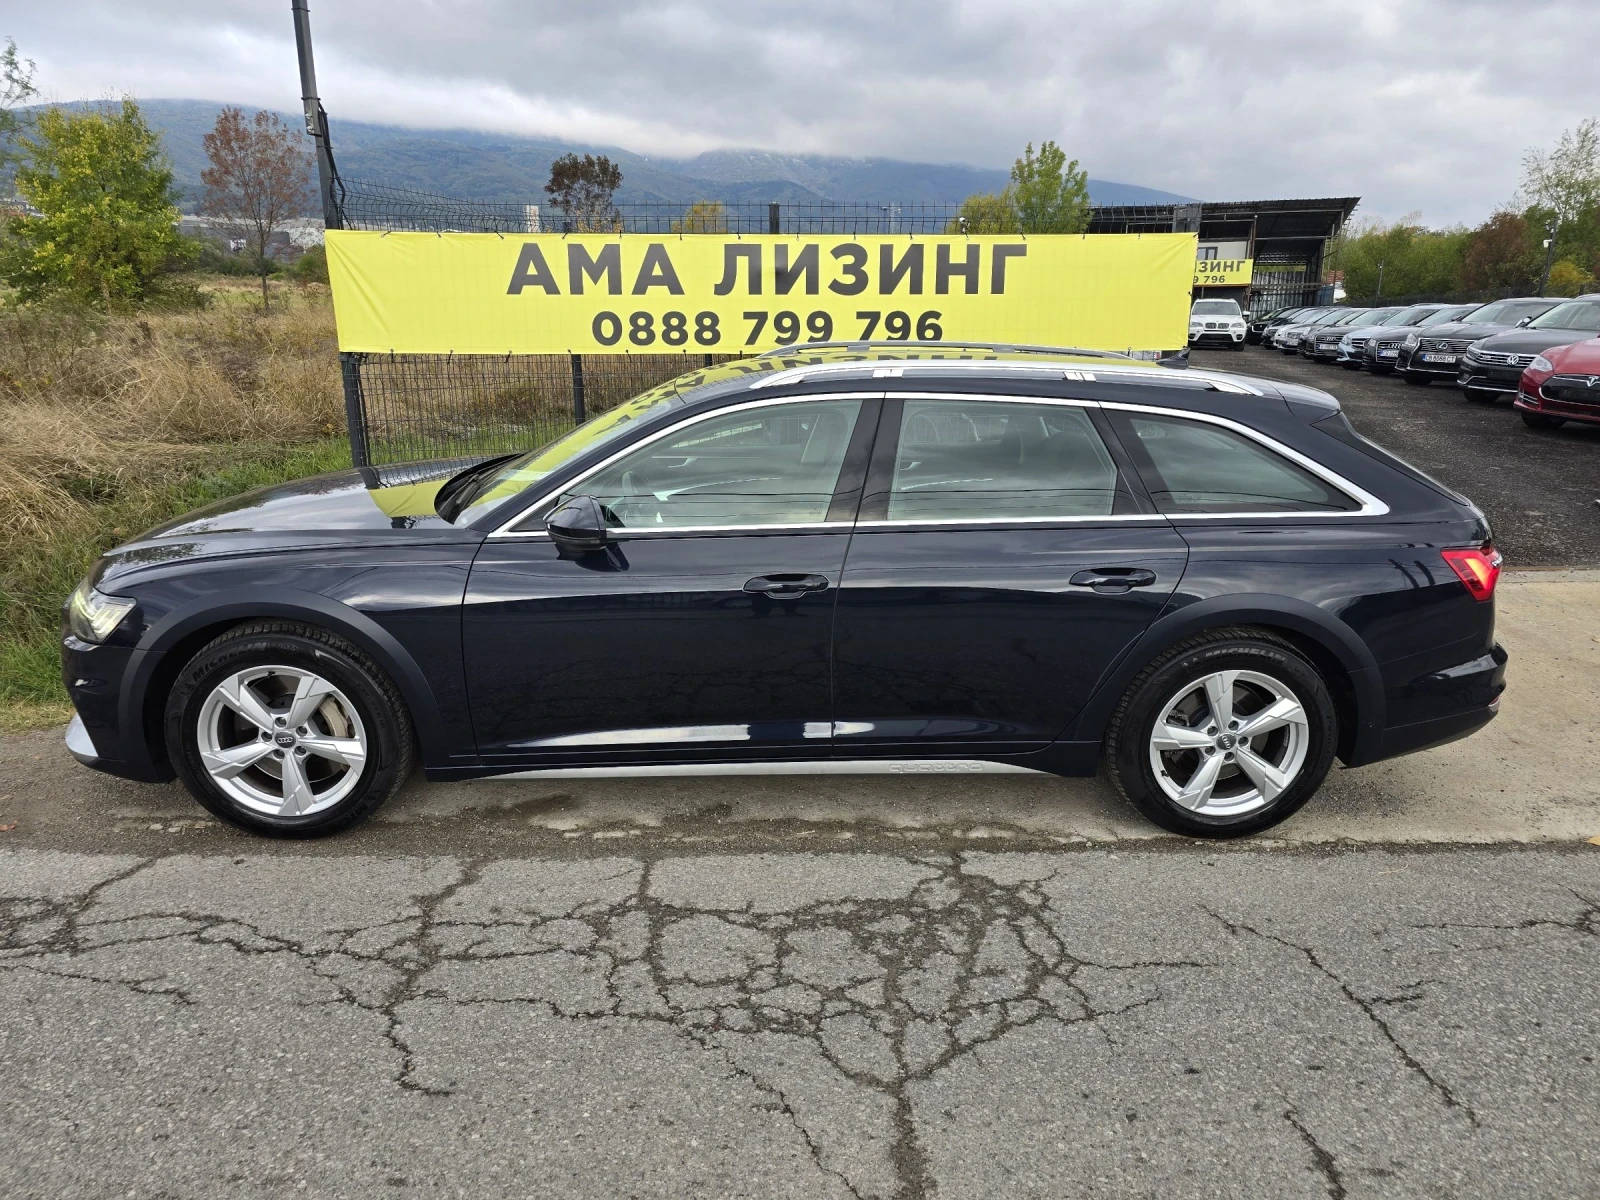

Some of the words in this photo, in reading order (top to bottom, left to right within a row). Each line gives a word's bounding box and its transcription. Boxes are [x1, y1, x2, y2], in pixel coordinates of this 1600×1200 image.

[506, 242, 686, 296] АМА
[713, 242, 1027, 296] ЛИЗИНГ
[1195, 260, 1246, 273] ЗИНГ
[1203, 275, 1226, 284] 796
[591, 310, 722, 347] 0888
[742, 310, 834, 346] 799
[855, 310, 943, 342] 796
[888, 762, 984, 774] quattro
